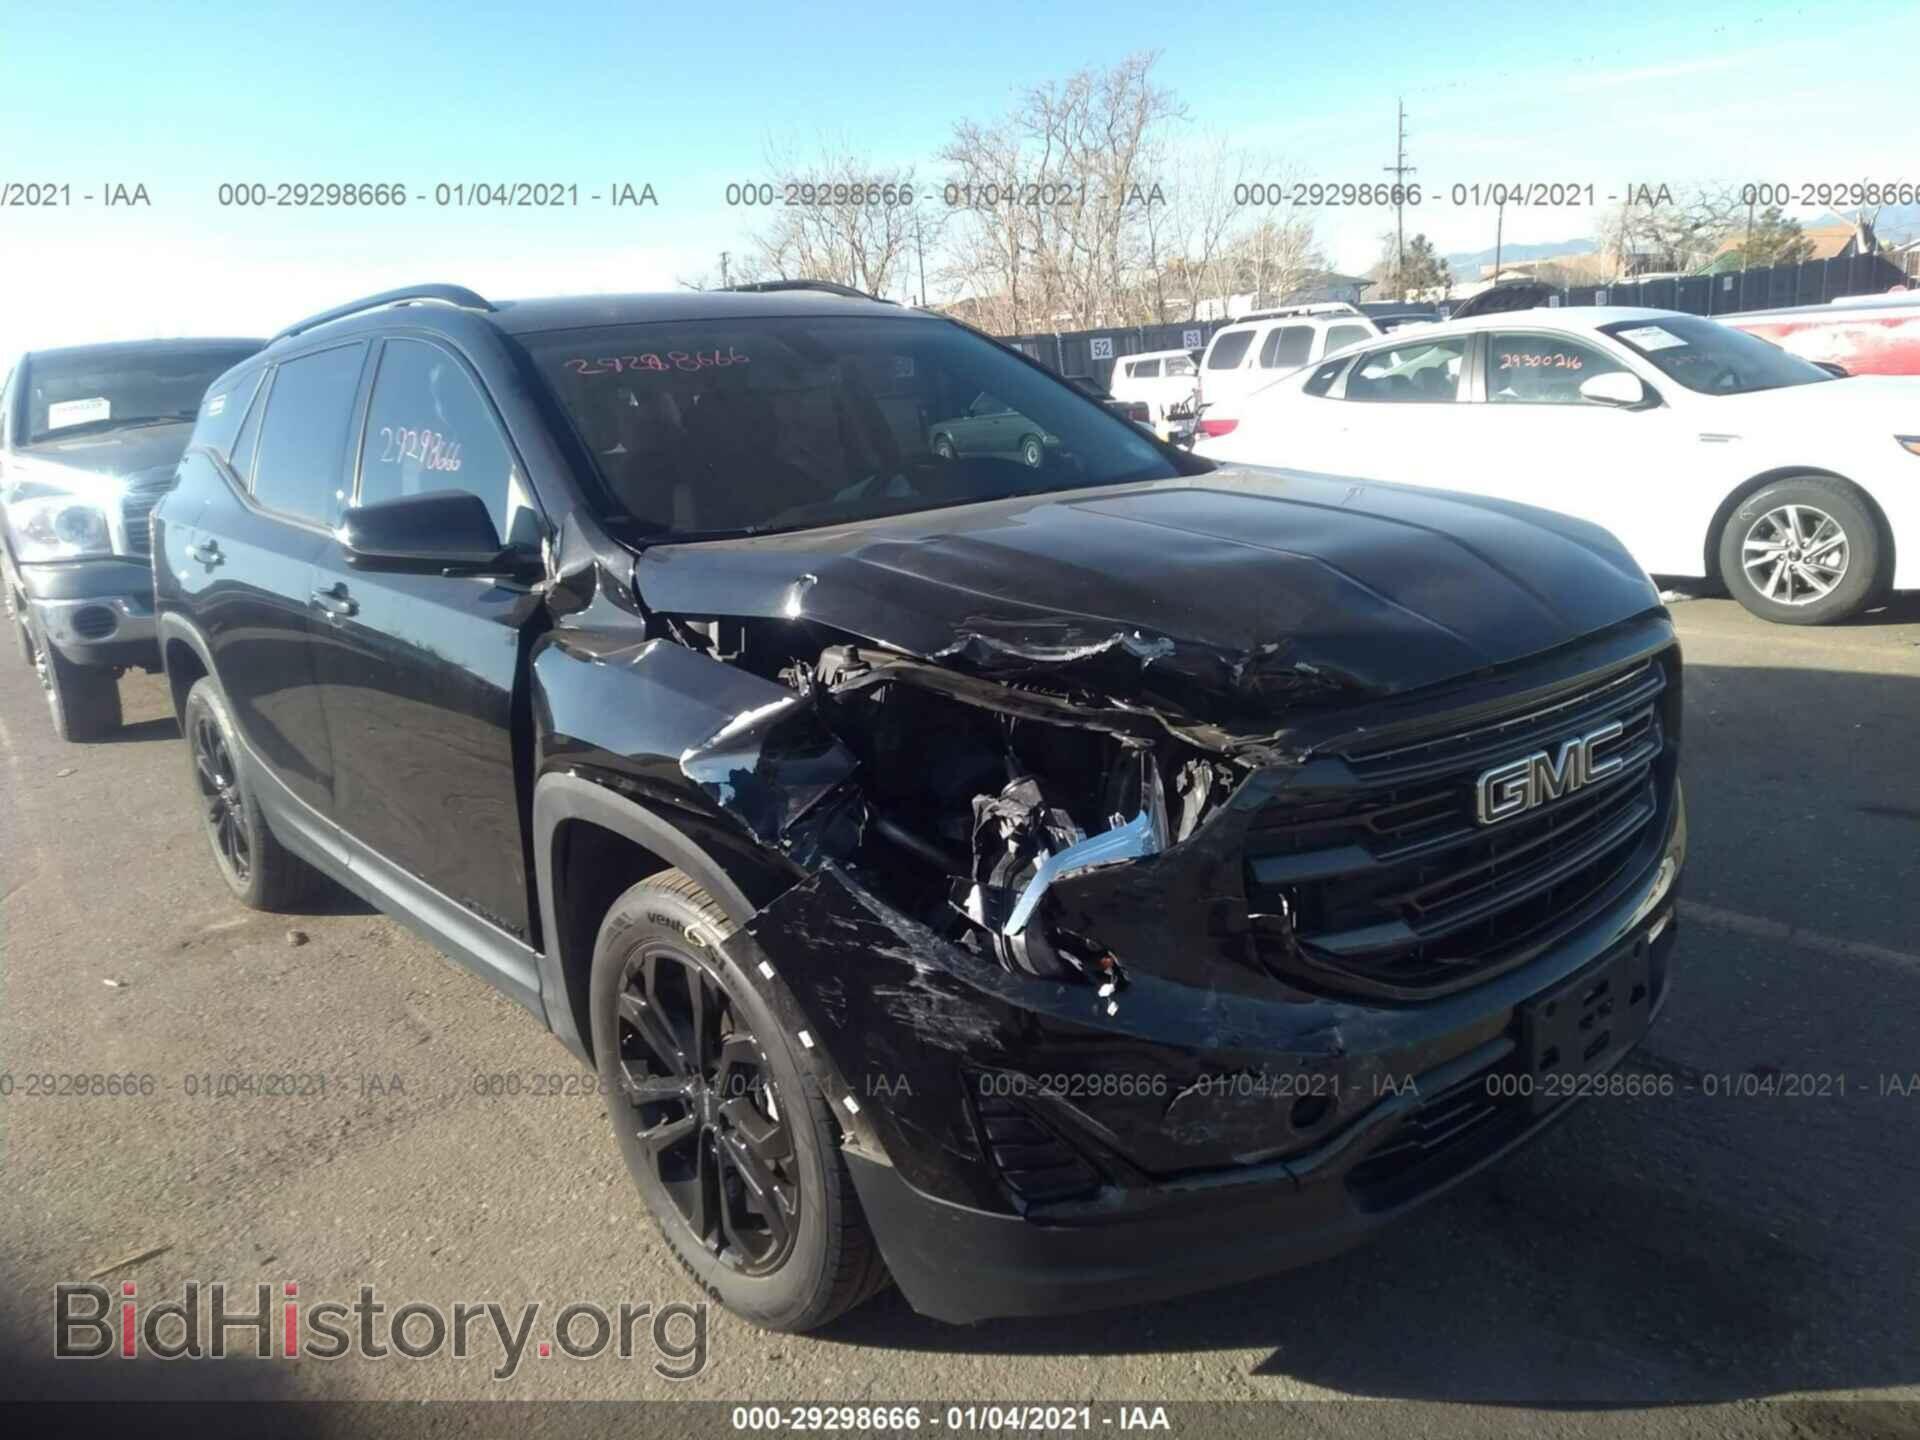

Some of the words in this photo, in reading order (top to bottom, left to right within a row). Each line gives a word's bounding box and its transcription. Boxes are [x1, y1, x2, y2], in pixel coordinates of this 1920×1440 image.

[1094, 340, 1111, 356] 52
[1499, 353, 1583, 369] 29300216
[1477, 722, 1624, 824] GMC
